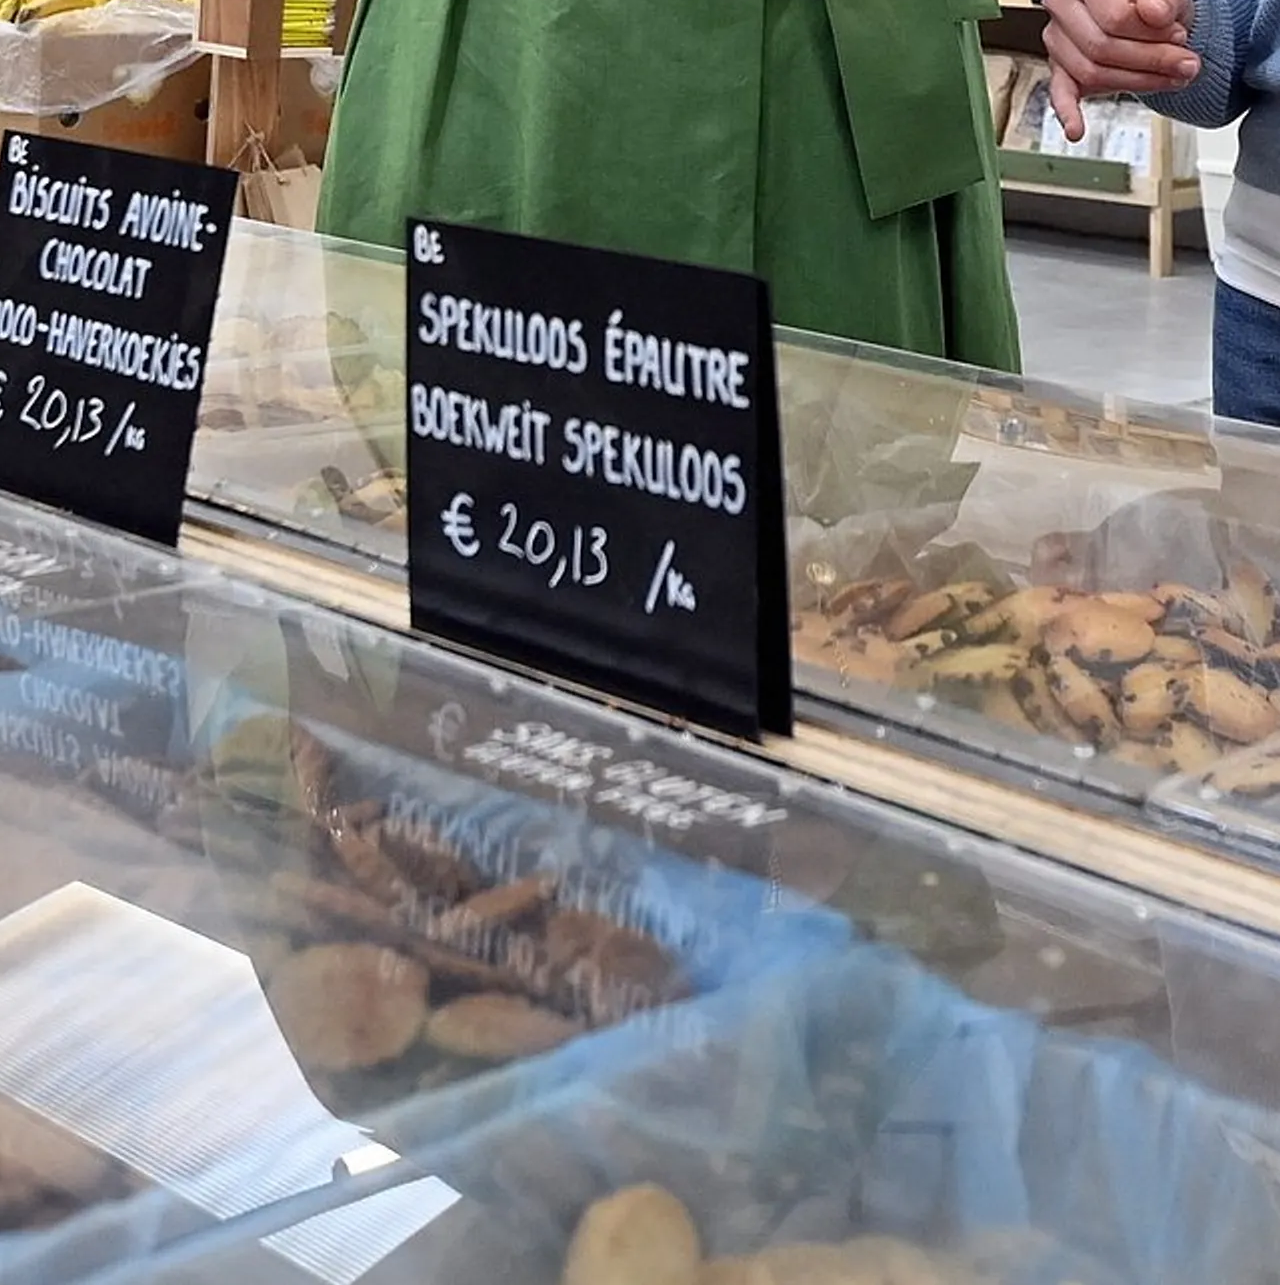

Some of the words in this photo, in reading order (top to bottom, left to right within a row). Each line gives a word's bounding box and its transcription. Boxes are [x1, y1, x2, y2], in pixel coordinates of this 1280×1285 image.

[7, 134, 30, 166] BE
[39, 238, 153, 300] CHOCOLAT
[413, 225, 446, 265] BE
[418, 292, 588, 374] SPEKULOOS
[604, 308, 750, 409] ÉPAUTRE
[19, 374, 107, 451] 20,13
[561, 417, 747, 515] SPEKULOOS
[496, 502, 609, 589] 20,13
